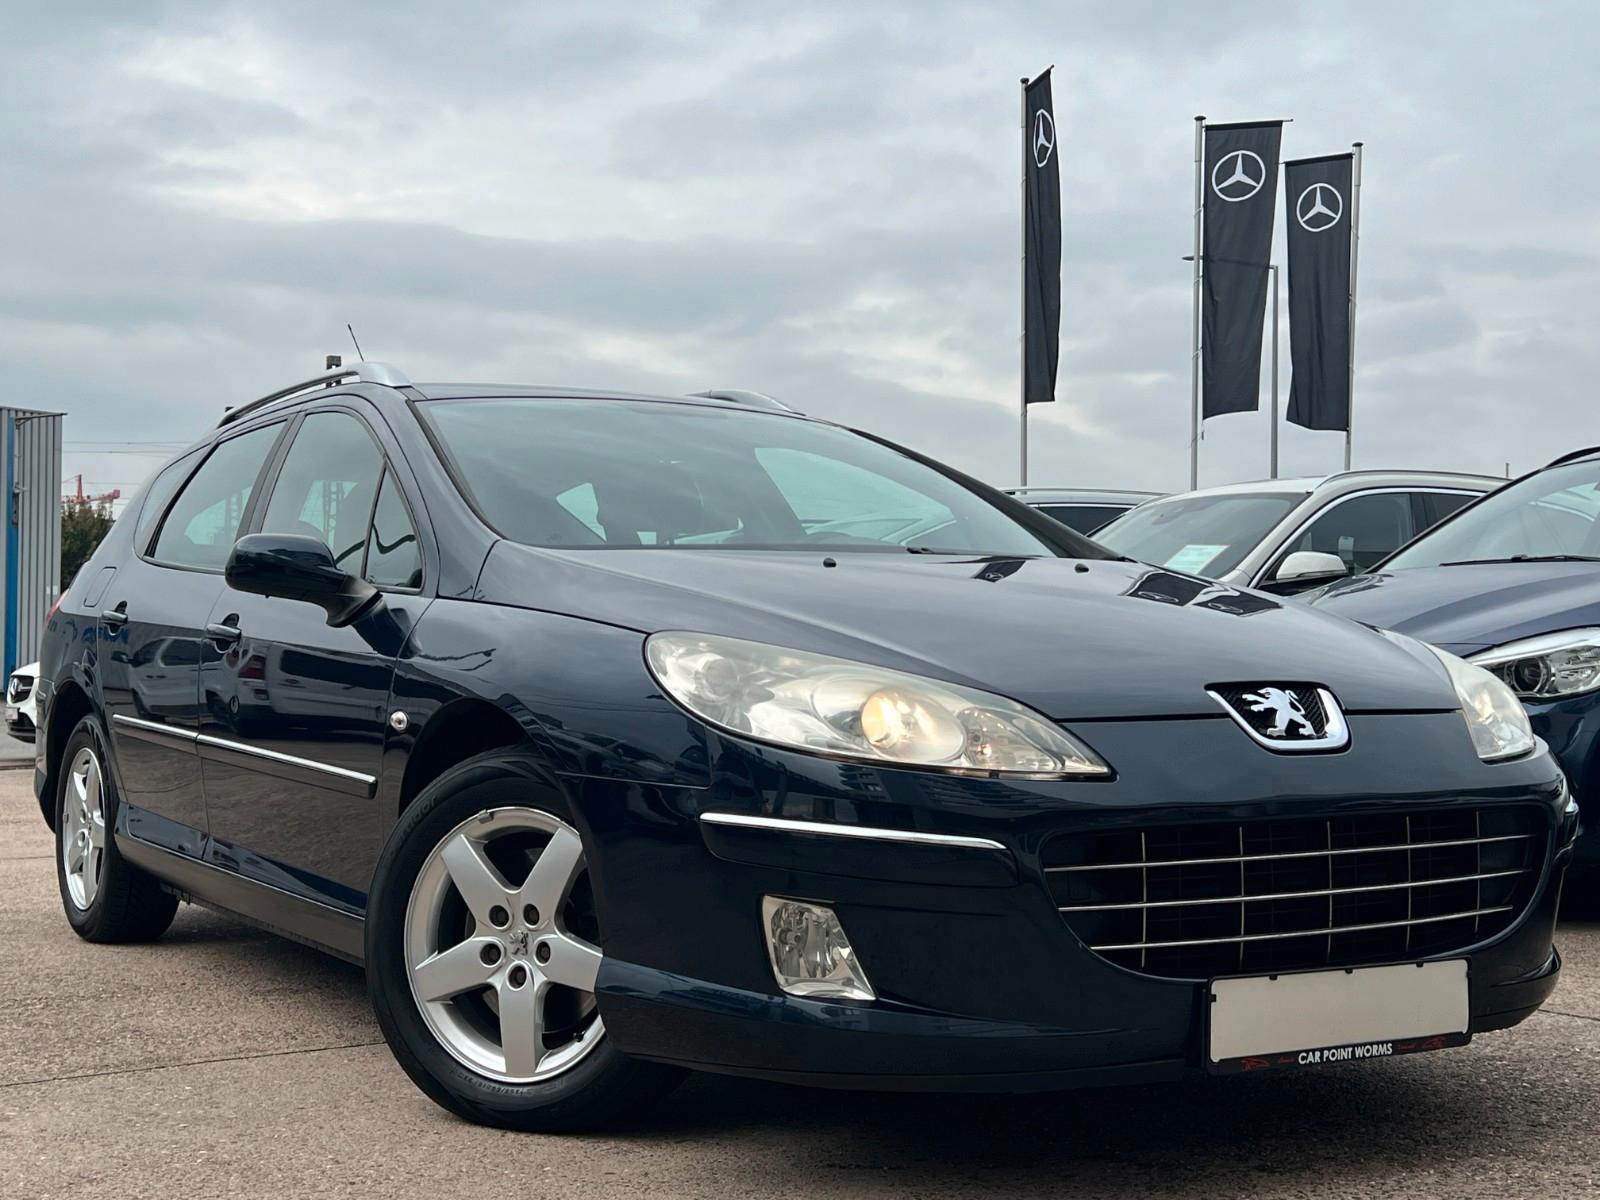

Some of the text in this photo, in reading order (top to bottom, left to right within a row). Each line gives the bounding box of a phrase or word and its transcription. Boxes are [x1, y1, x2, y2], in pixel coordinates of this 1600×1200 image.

[1298, 1043, 1393, 1065] CAR POINT WORMS
